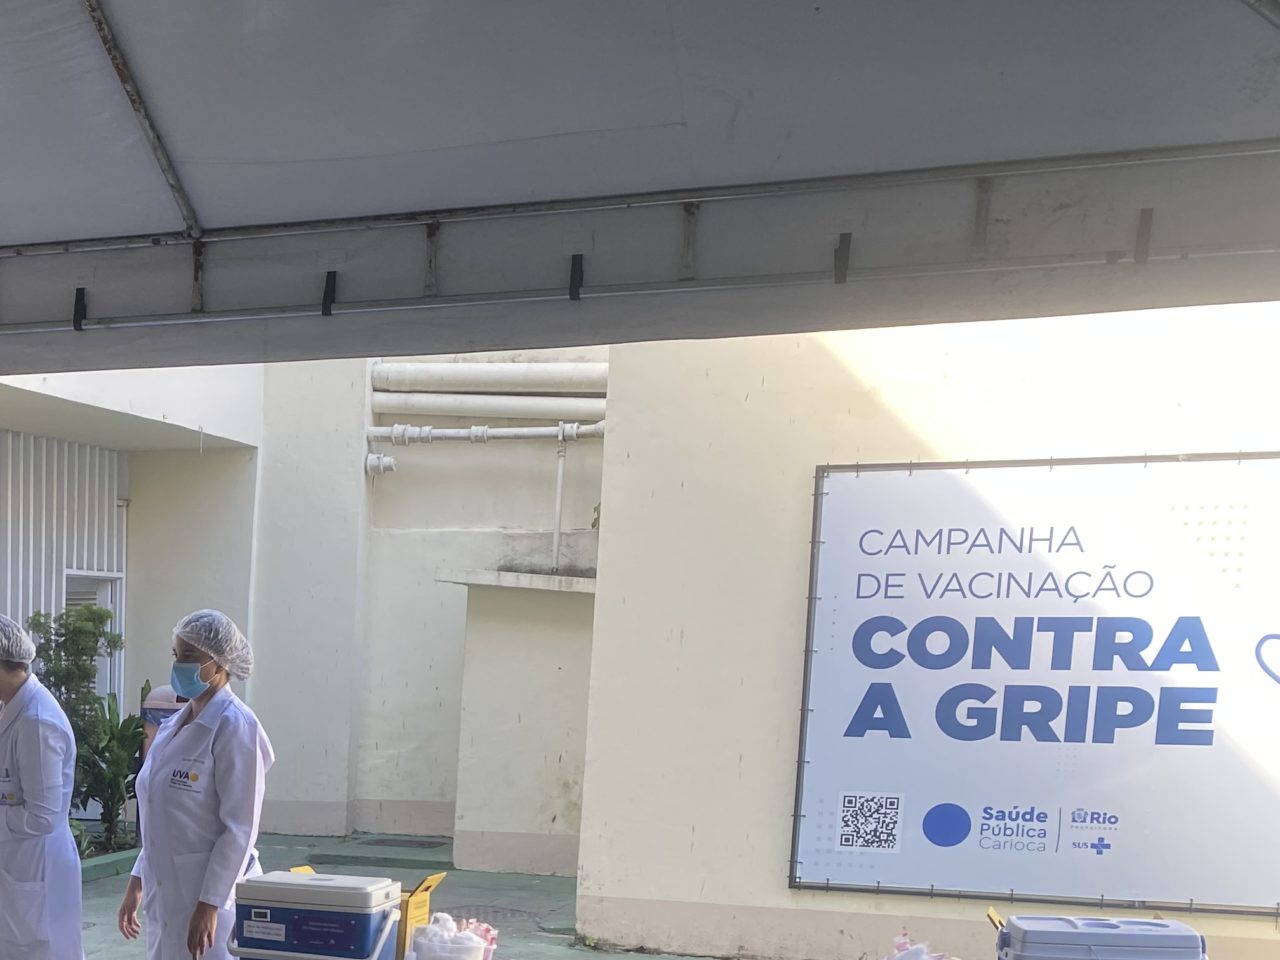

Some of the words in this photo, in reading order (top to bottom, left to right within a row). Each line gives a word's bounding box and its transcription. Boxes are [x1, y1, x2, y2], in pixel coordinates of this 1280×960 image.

[858, 526, 1085, 556] CAMPANHA
[855, 572, 906, 599] DE
[918, 564, 1155, 604] VACINAÇÃO
[851, 615, 1221, 672] CONTRA
[842, 682, 913, 739] A
[934, 682, 1219, 746] GRIPE
[172, 769, 190, 780] UVA
[981, 805, 1049, 823] Saúde
[1089, 811, 1119, 825] Rio
[979, 822, 1047, 839] Pública
[978, 836, 1046, 852] Carioca
[1071, 841, 1089, 849] SUS
